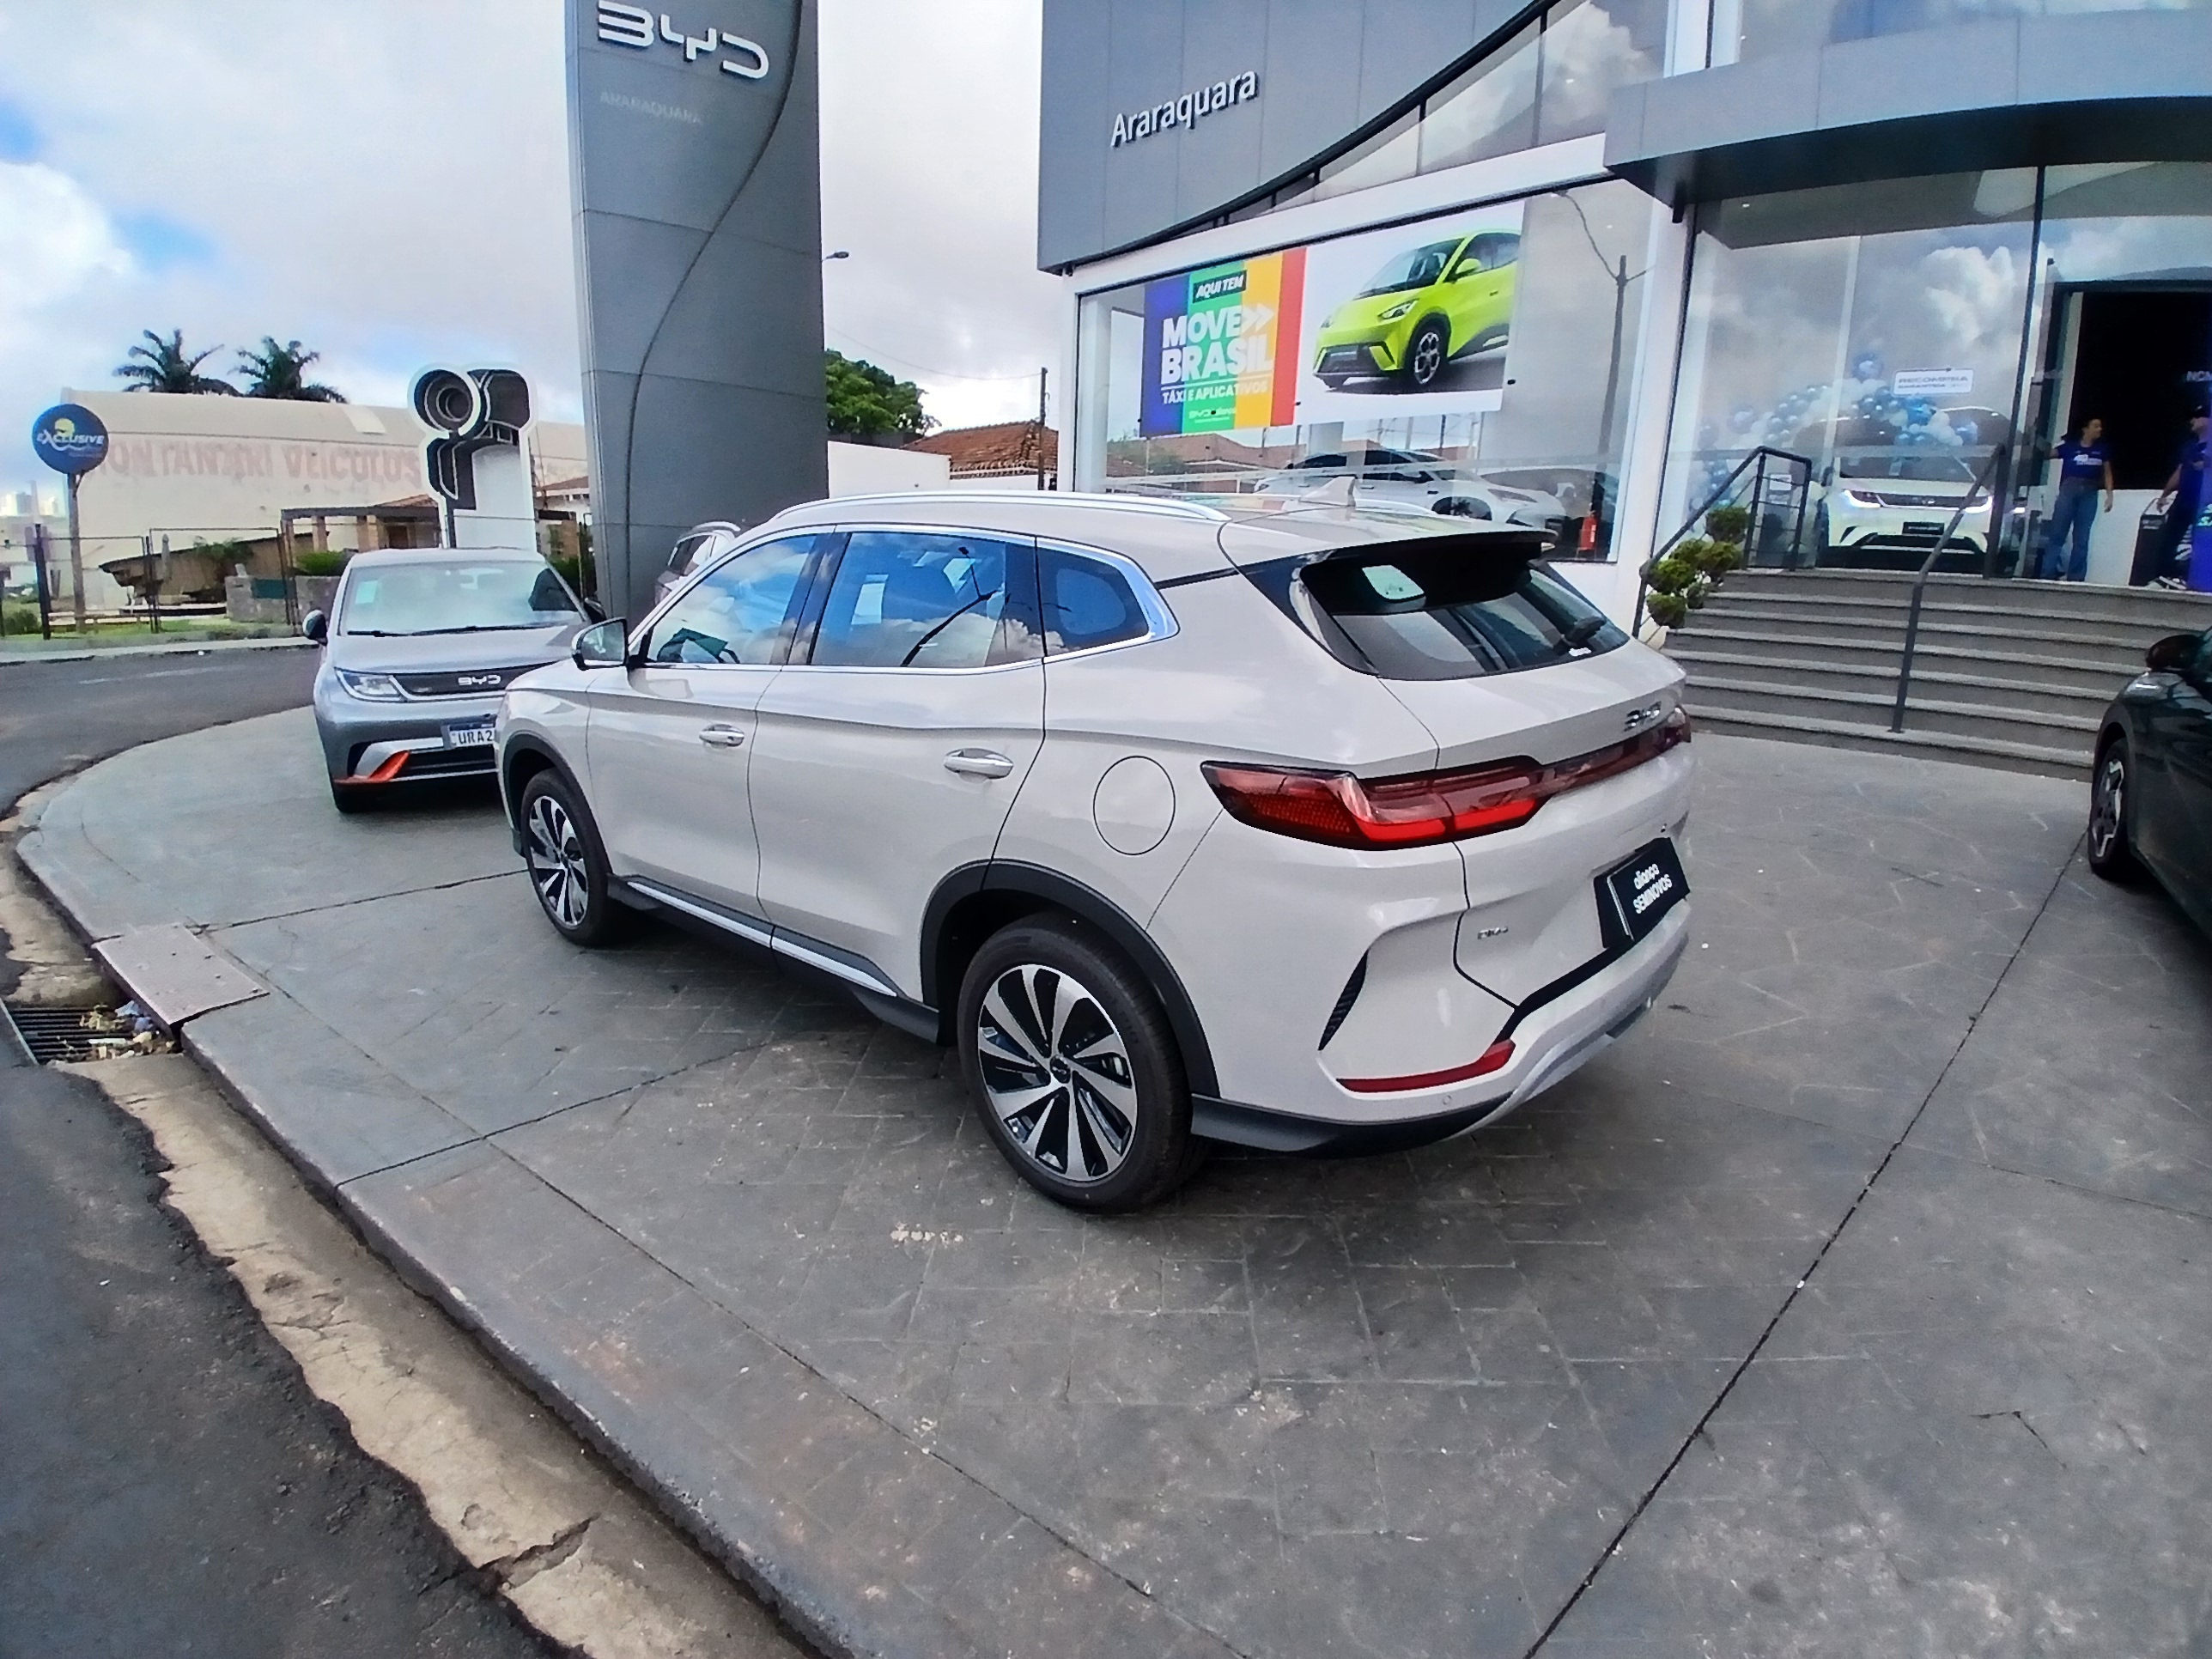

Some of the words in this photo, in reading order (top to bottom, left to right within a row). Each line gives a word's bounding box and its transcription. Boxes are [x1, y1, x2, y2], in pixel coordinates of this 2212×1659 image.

[598, 0, 769, 79] BYD
[1110, 70, 1260, 147] Araraquara
[1195, 280, 1224, 299] AQUI
[1222, 274, 1243, 293] TEM
[1163, 305, 1243, 348] MOVE
[1161, 333, 1274, 385] BRASIL
[1188, 390, 1194, 400] E
[1194, 380, 1267, 400] APLICATIVOS
[100, 438, 274, 478] ONTANARI
[458, 674, 501, 686] BYD
